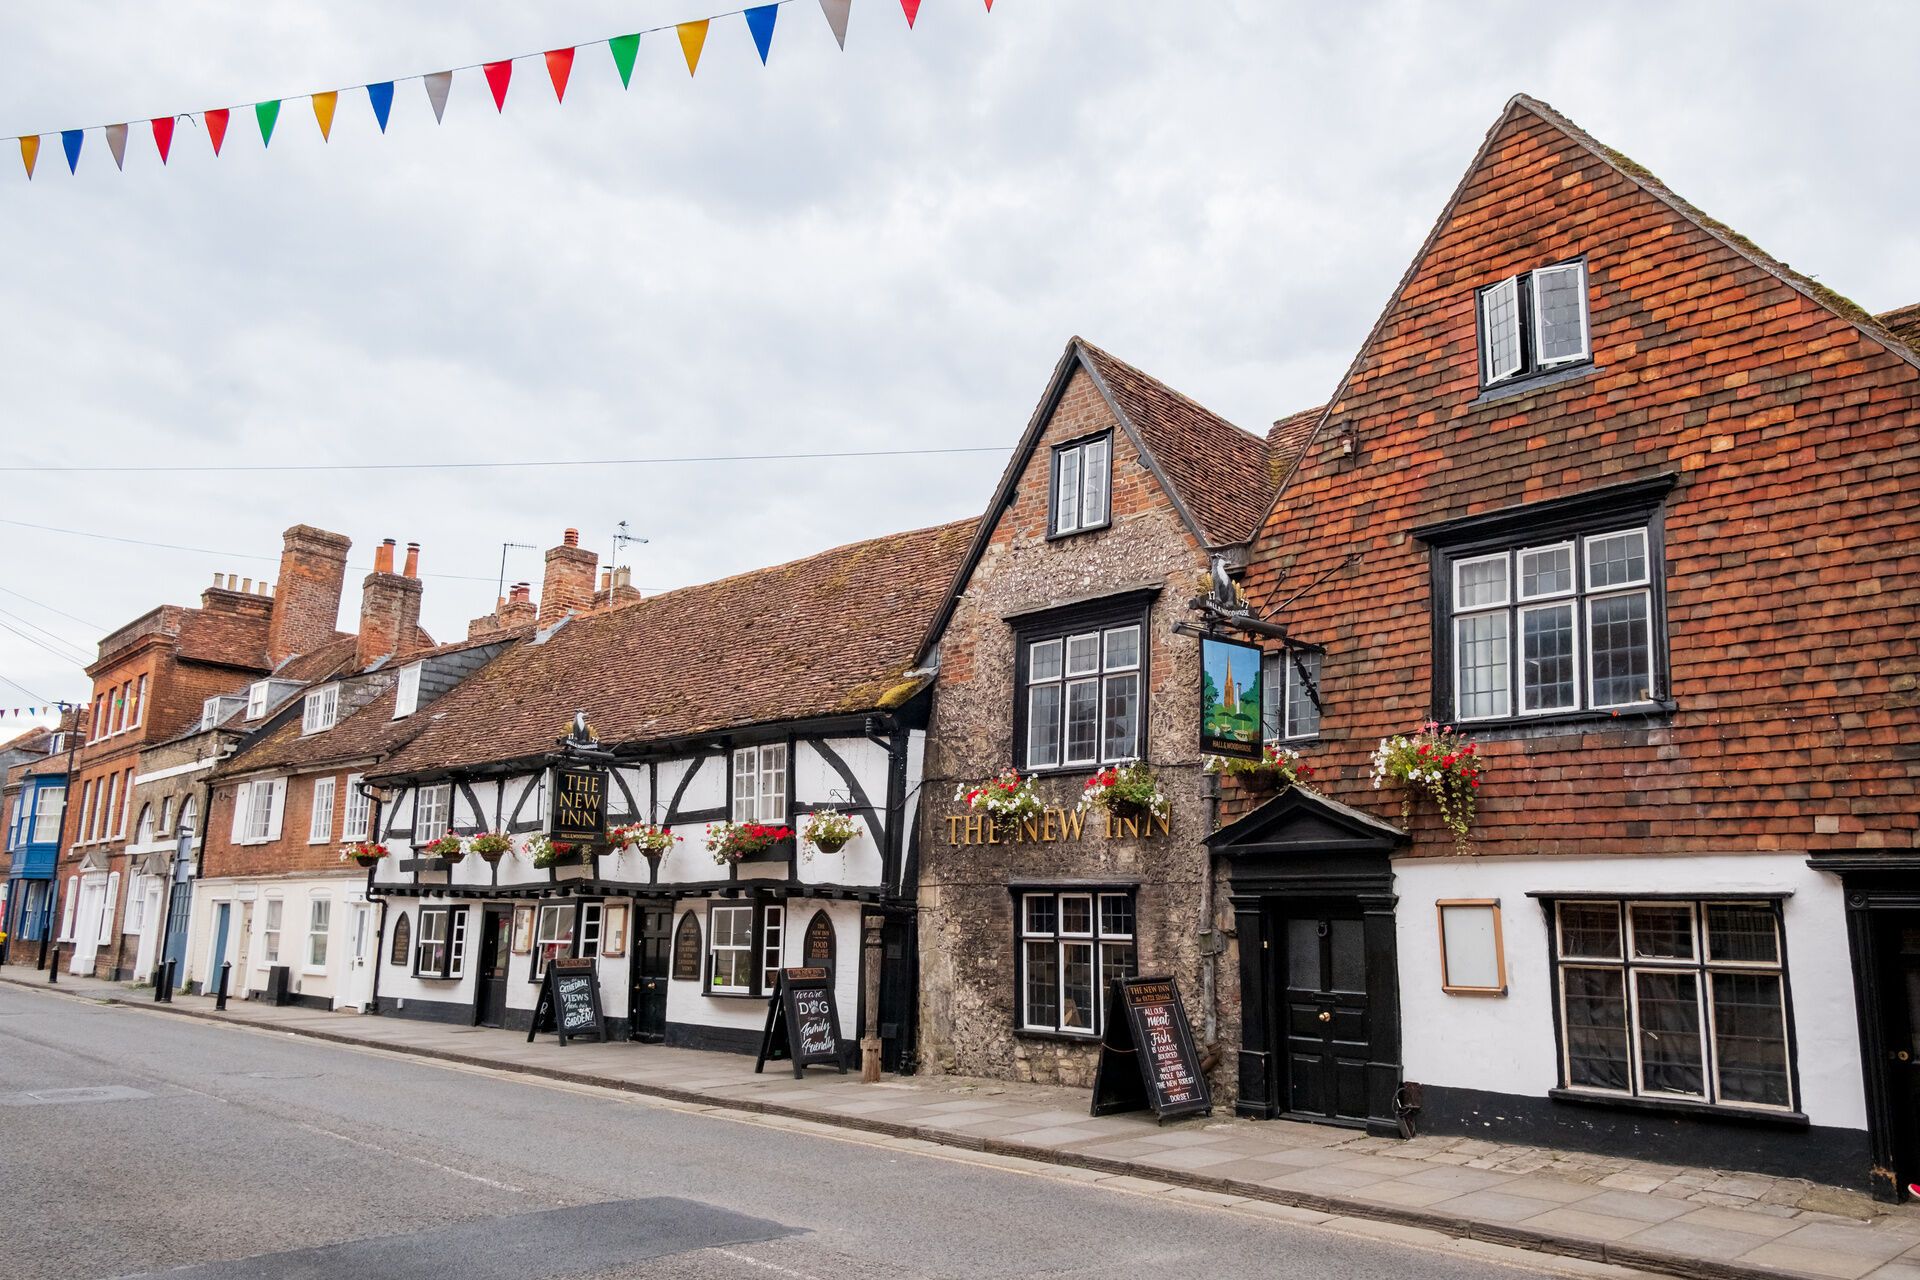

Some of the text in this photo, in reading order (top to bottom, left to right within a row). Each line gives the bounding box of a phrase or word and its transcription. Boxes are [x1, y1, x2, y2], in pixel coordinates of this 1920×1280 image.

[565, 774, 599, 793] THE
[559, 791, 601, 810] NEW
[561, 809, 597, 827] INN
[946, 802, 1172, 846] THE NEW INN
[813, 941, 828, 949] FOOD
[559, 979, 588, 993] CATHEDRAL
[1130, 986, 1143, 995] THE
[1158, 984, 1170, 992] INN
[561, 993, 589, 1002] VIEWS
[564, 1011, 594, 1027] GARDEN!
[1144, 1008, 1153, 1016] ALL
[800, 1018, 830, 1040] Family
[801, 1036, 835, 1056] Friendly
[1150, 1029, 1173, 1047] Fish
[1157, 1043, 1178, 1053] LOCALLY
[1157, 1052, 1178, 1060] SOURCED
